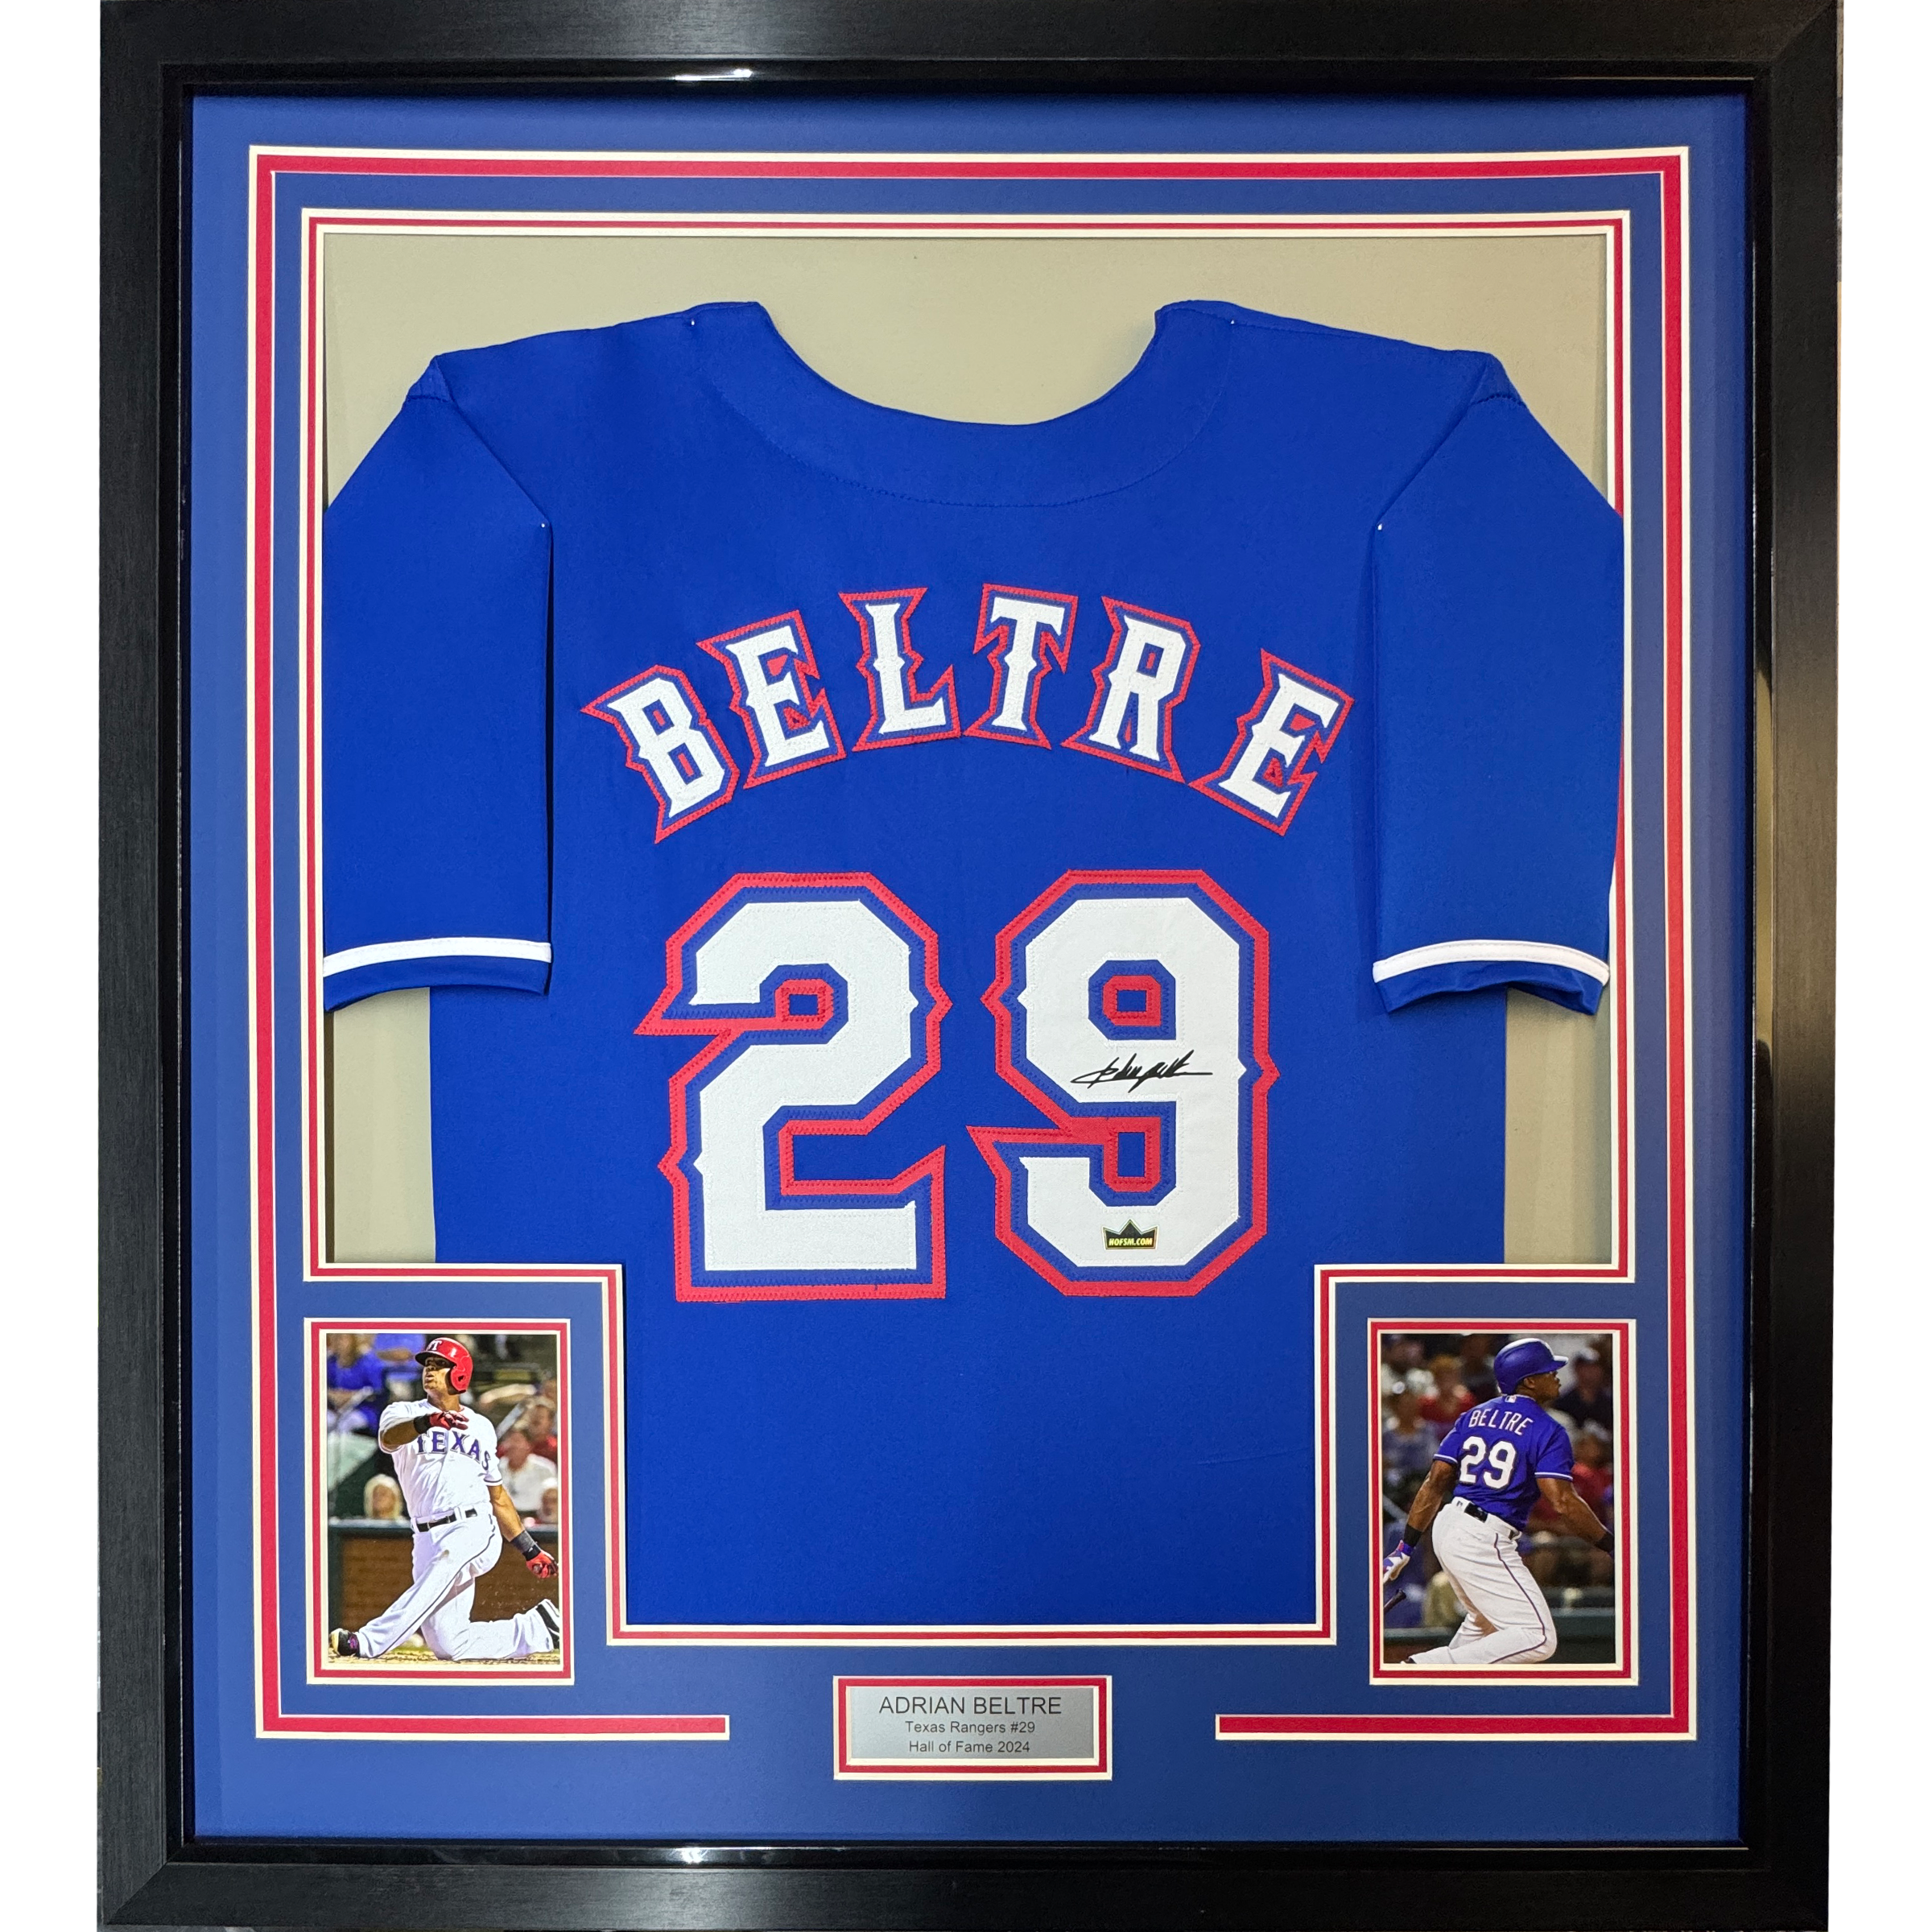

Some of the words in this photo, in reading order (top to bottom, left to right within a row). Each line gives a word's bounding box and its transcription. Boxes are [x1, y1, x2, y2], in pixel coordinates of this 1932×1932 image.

[580, 583, 1355, 844] BELTRE
[634, 869, 1280, 1302] 29
[1108, 1237, 1153, 1246] HOFSM.COM
[1468, 1408, 1534, 1436] BELTRE
[416, 1430, 492, 1472] TEXAS
[1459, 1435, 1517, 1490] 29
[878, 1696, 965, 1715] ADRIAN
[973, 1696, 1062, 1715] BELTRE
[905, 1720, 946, 1733] Texas
[950, 1721, 1006, 1736] Rangers
[1010, 1721, 1035, 1733] #29
[909, 1740, 934, 1753] Hall
[939, 1740, 952, 1752] of
[956, 1740, 993, 1753] Fame
[997, 1740, 1030, 1753] 2024
